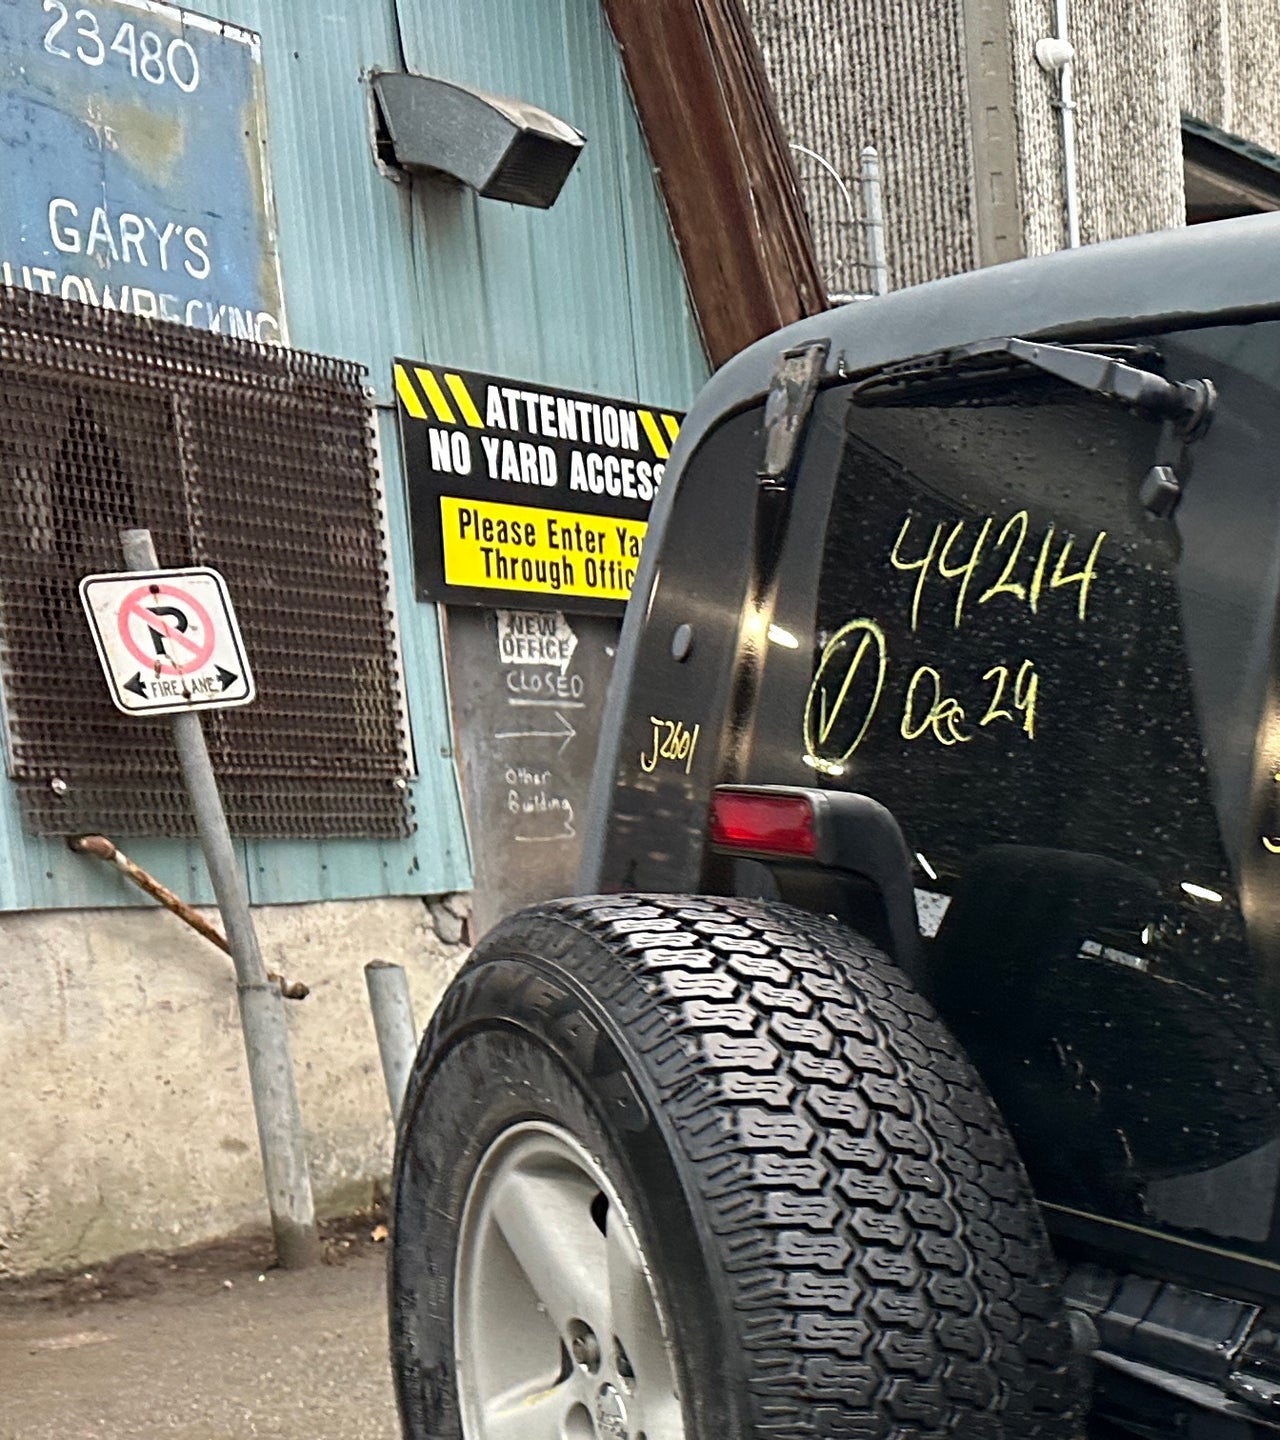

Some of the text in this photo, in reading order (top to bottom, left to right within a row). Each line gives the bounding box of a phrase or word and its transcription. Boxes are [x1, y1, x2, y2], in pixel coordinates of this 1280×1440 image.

[43, 1, 200, 93] 23480
[49, 198, 210, 280] GARY'S
[486, 384, 639, 451] ATTENTION
[428, 427, 471, 476] NO
[481, 436, 557, 487] YARD
[458, 507, 646, 558] Please Enter Ya
[480, 546, 635, 591] Through Offic
[889, 509, 1106, 630] 44214
[502, 636, 570, 661] OFFICE
[511, 614, 558, 637] NEW
[150, 679, 180, 698] FIRE
[507, 670, 584, 698] CLOSED
[980, 659, 1040, 740] 29
[641, 717, 700, 774] J2601
